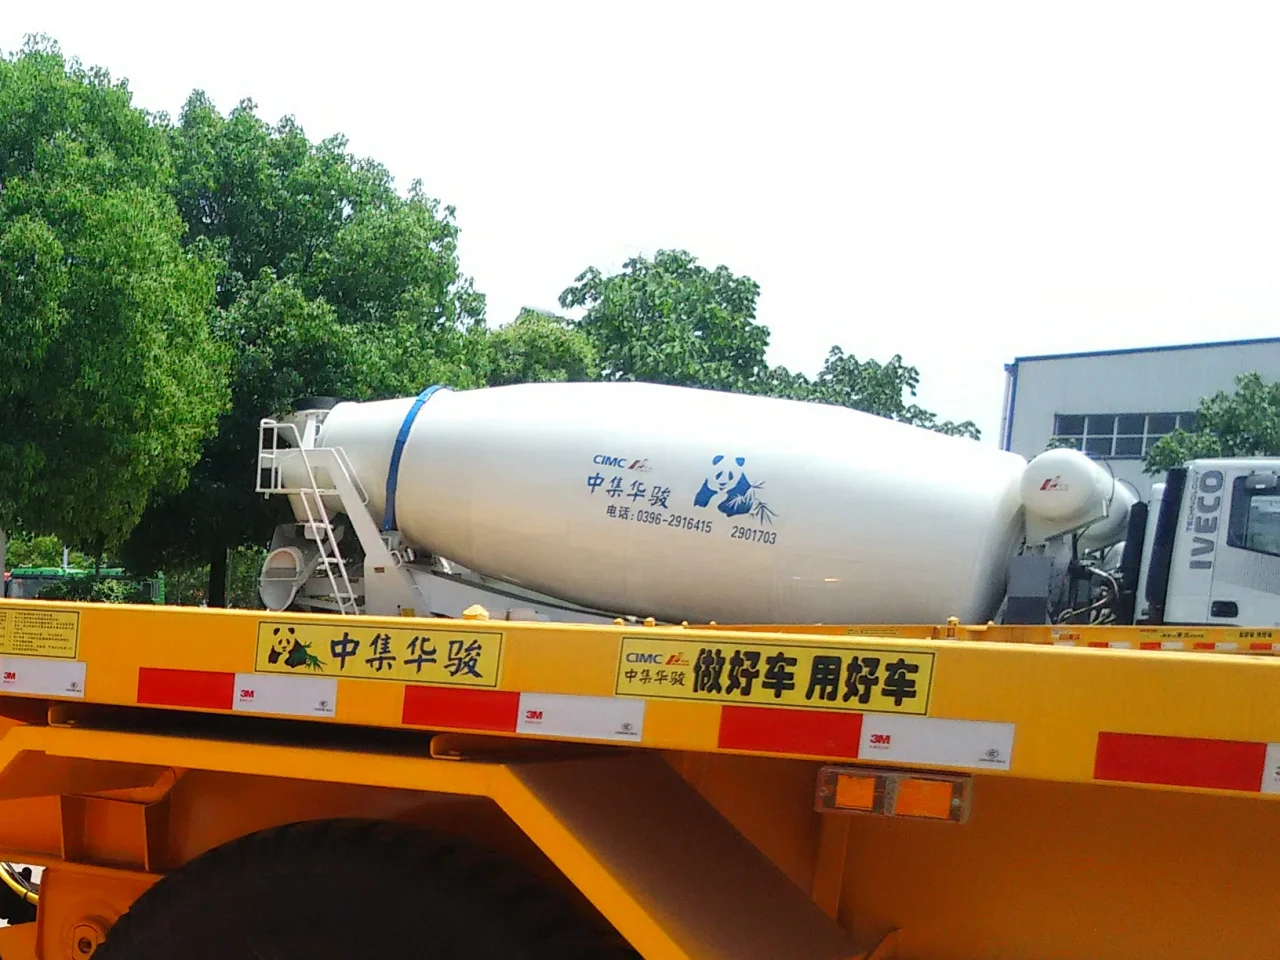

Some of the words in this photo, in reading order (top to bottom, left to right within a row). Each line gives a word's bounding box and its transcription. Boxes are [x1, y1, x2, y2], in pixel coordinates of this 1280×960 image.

[593, 454, 627, 468] CIMC
[587, 472, 671, 509] 中集华骏
[1188, 470, 1224, 570] IVECO
[730, 525, 778, 545] 2901703
[330, 632, 484, 679] 中集华骏
[626, 652, 663, 665] CIMC
[3, 671, 16, 680] 3M
[624, 668, 685, 686] 中集华骏
[693, 648, 797, 698] 做好车
[805, 655, 919, 706] 用好车
[240, 689, 254, 698] 3M
[526, 710, 543, 720] 3M
[870, 734, 891, 745] 3M
